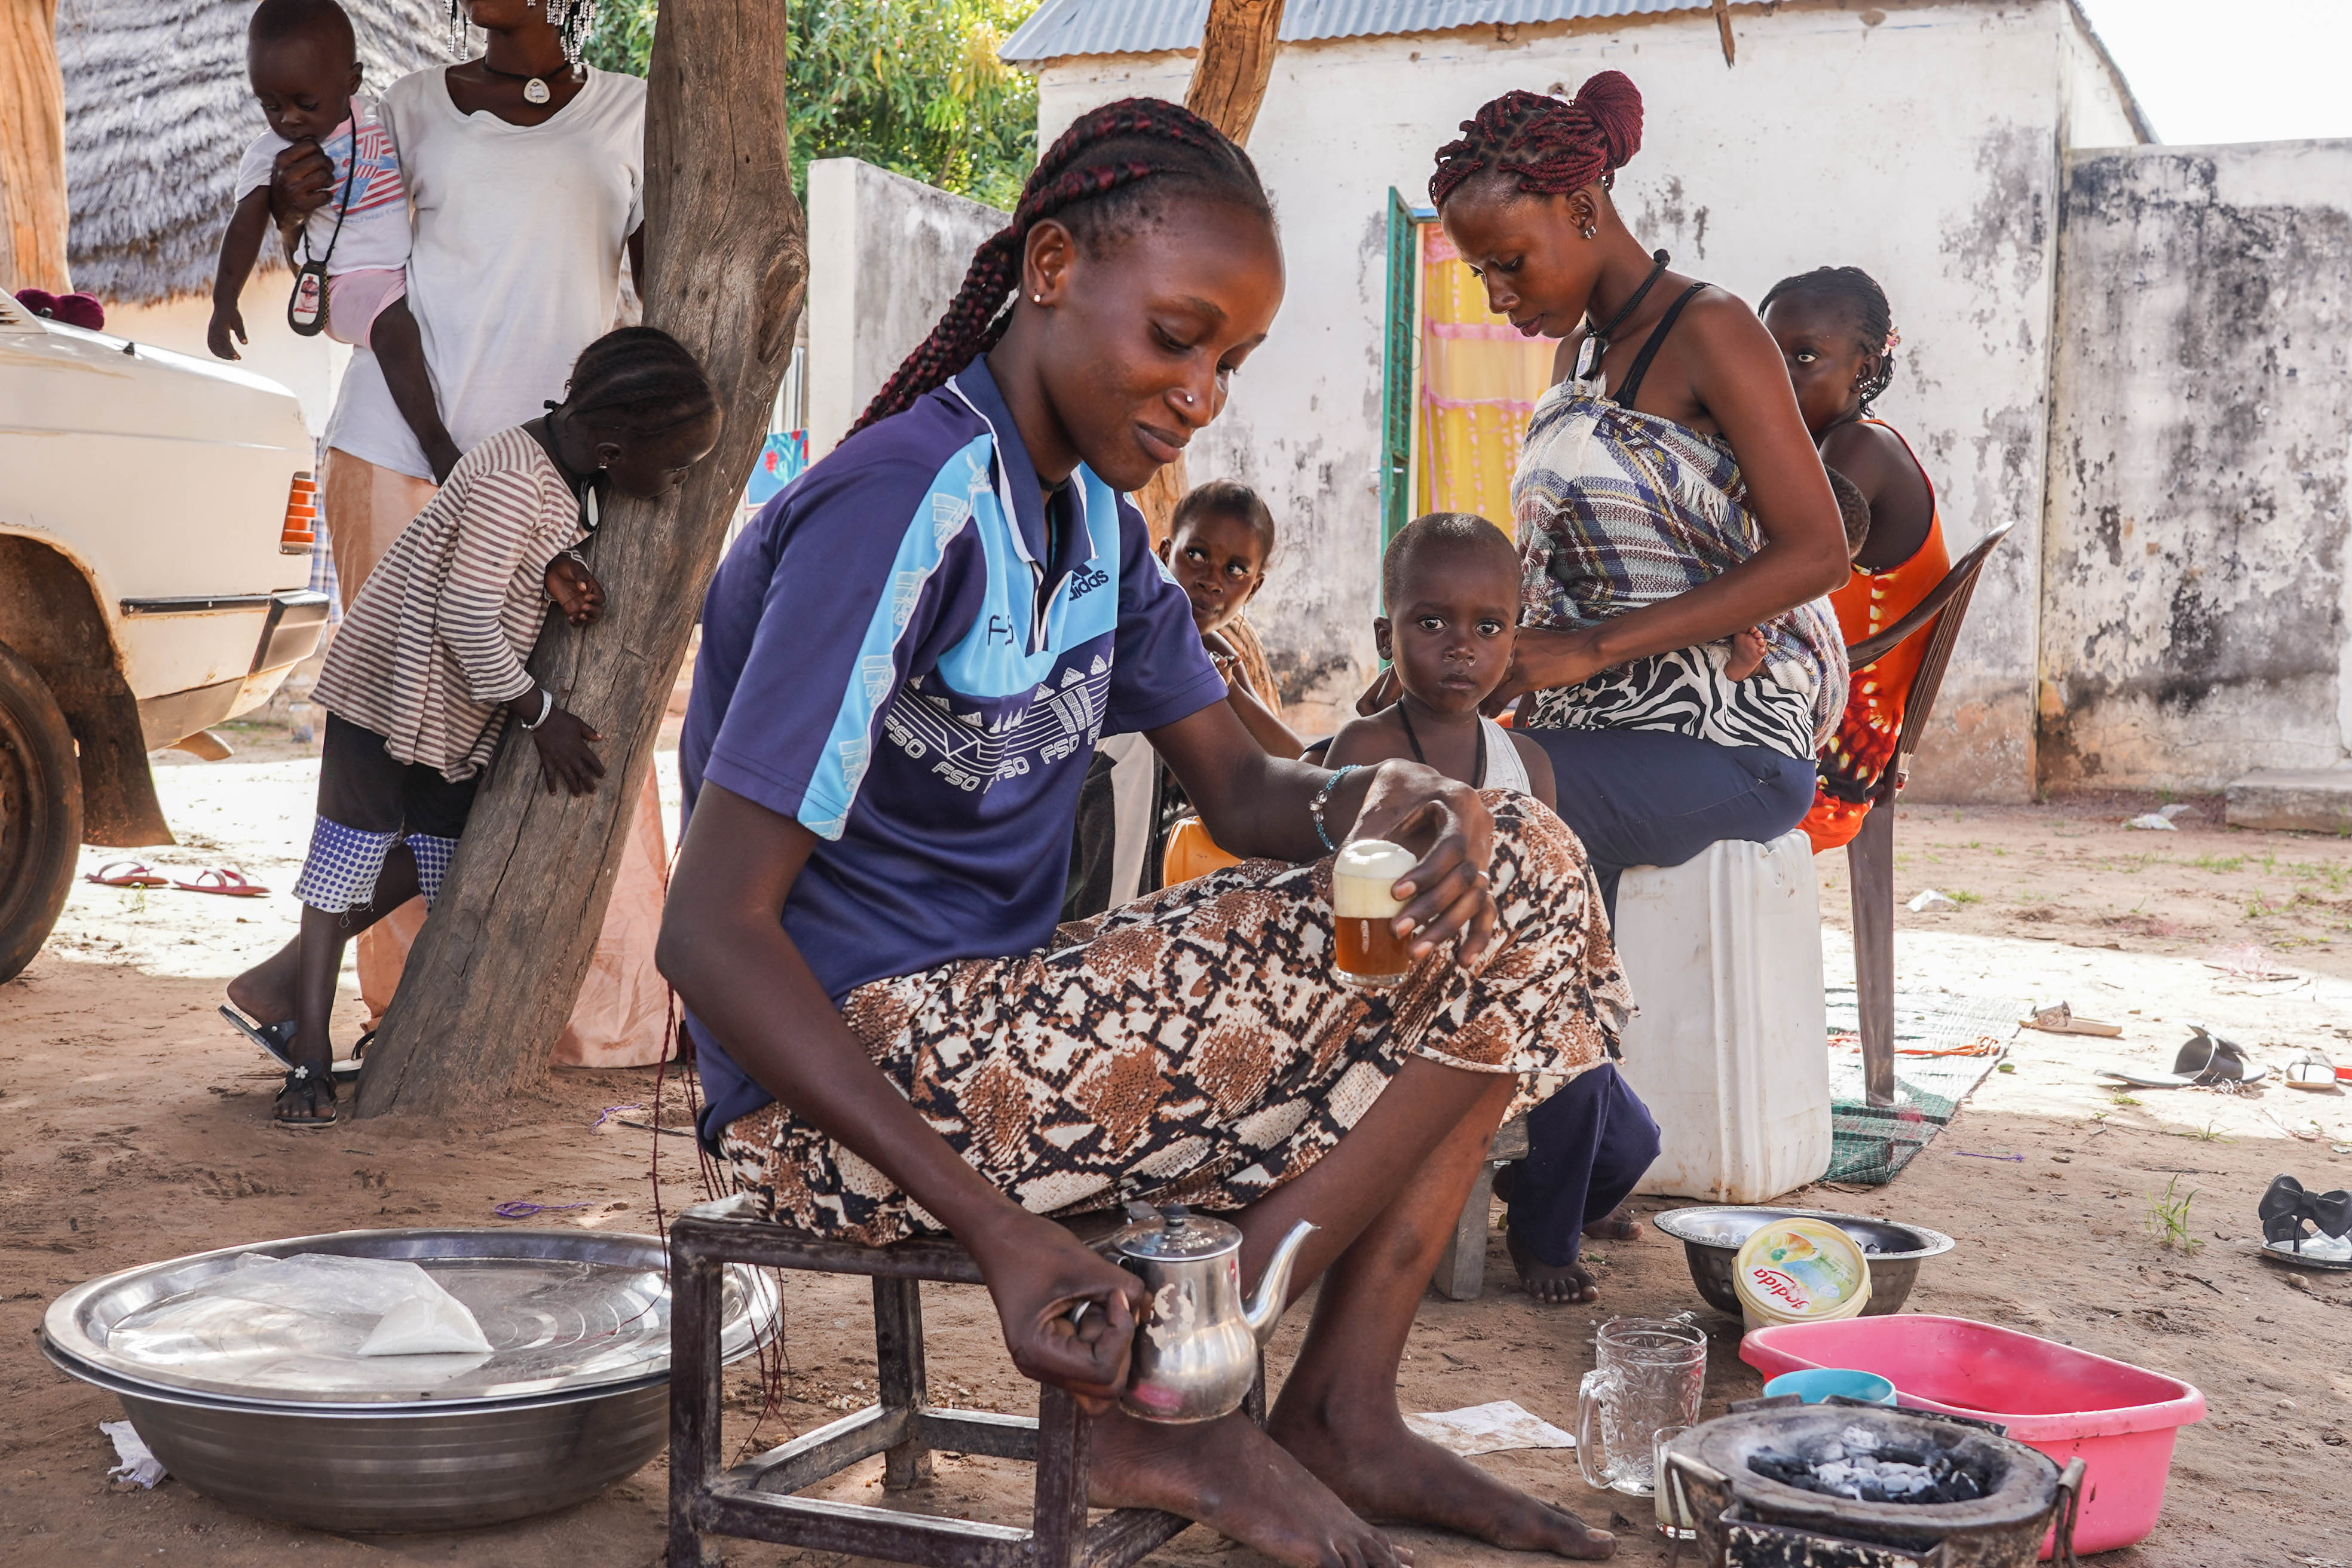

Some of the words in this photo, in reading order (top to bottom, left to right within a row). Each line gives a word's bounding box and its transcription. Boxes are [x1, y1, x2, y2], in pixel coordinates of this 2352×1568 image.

[1069, 569, 1109, 602] didas
[932, 761, 981, 792] FSO
[1040, 734, 1080, 765] FSO
